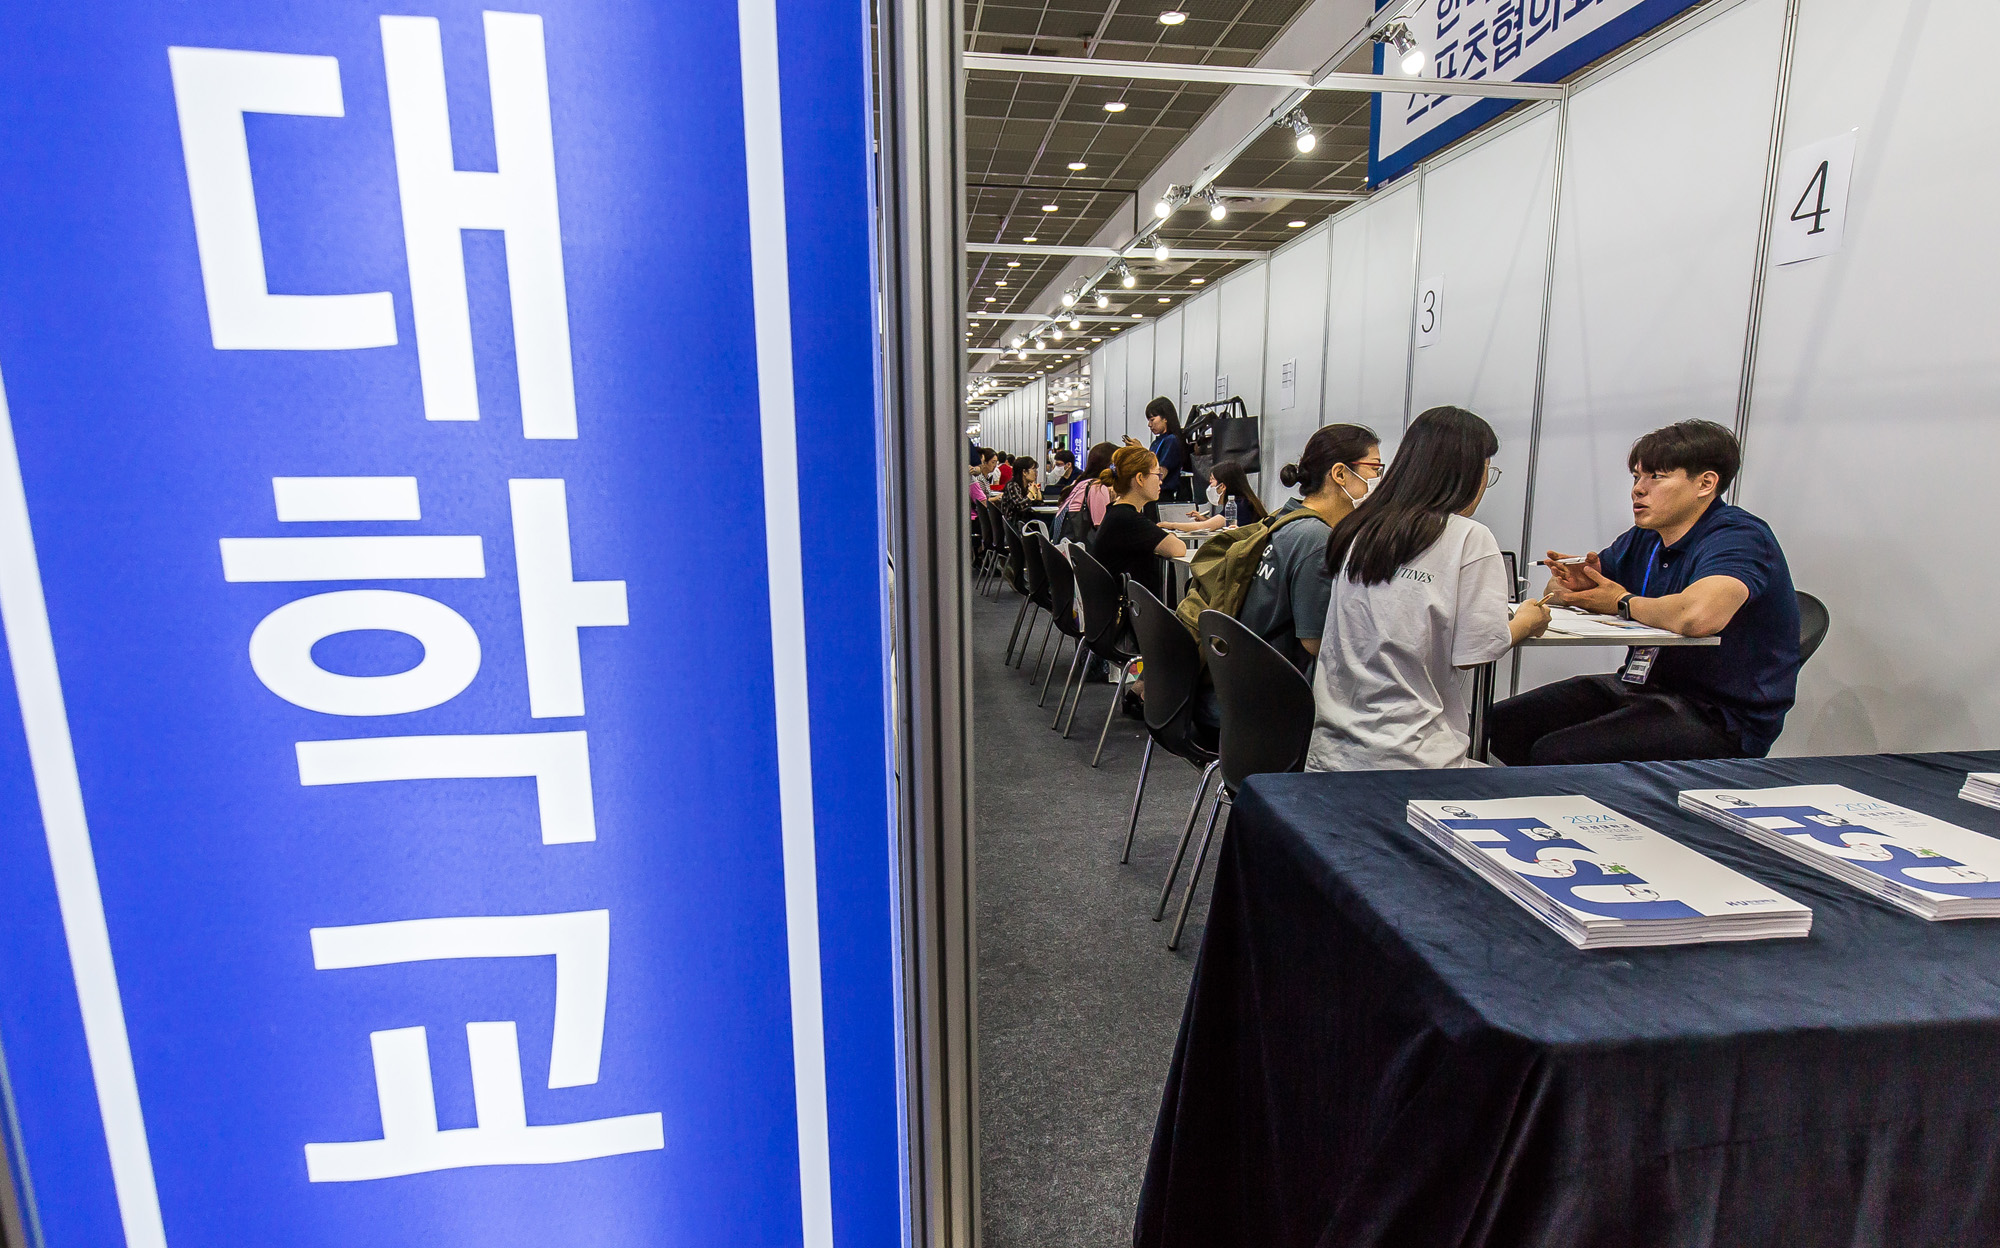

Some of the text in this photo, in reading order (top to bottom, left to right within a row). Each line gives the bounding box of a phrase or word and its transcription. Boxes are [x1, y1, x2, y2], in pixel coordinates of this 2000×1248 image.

[1790, 159, 1830, 236] 4
[1421, 290, 1436, 333] 3
[168, 11, 665, 1182] 대학교
[1562, 814, 1616, 824] 2024
[1835, 802, 1888, 812] 2024
